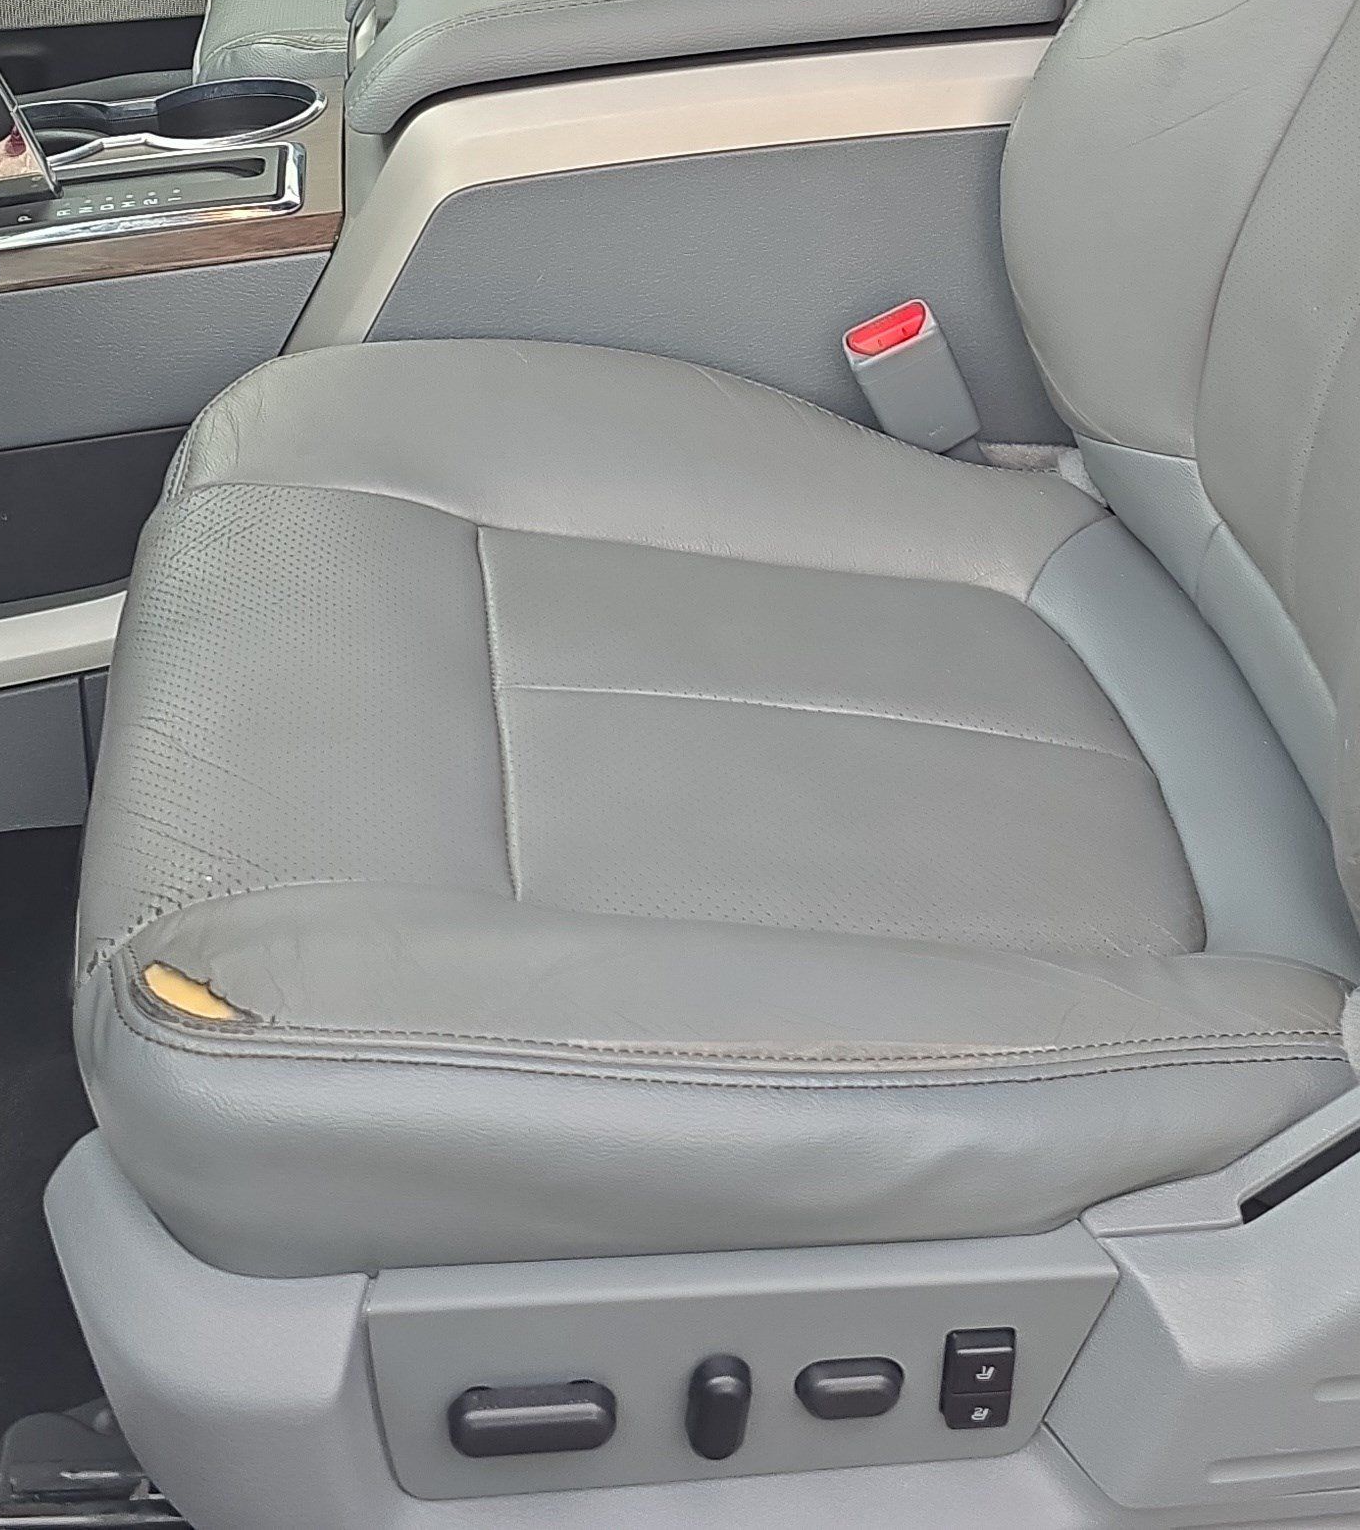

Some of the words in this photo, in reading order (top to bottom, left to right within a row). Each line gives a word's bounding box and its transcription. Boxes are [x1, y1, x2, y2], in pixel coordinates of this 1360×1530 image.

[57, 209, 71, 217] R
[100, 203, 114, 211] D
[144, 198, 158, 206] 2
